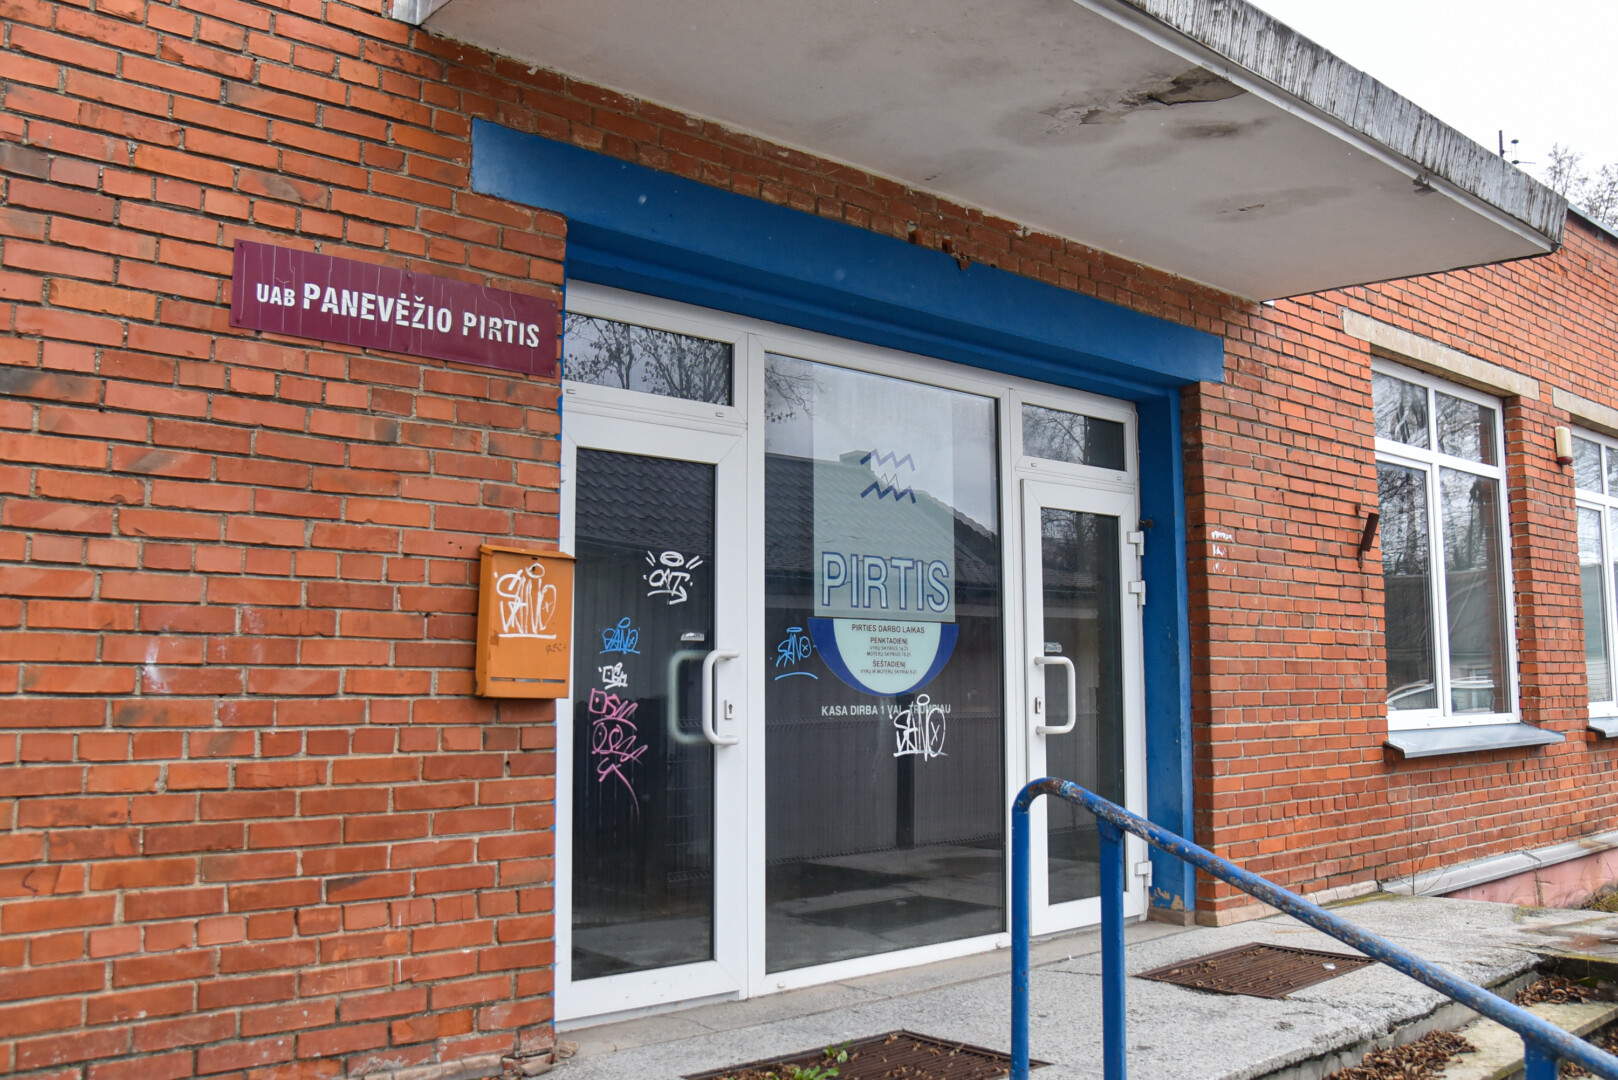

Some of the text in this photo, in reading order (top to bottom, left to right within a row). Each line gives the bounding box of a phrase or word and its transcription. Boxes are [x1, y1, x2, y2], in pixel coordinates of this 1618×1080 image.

[256, 283, 541, 349] UAB PANEVĖŽIO PIRTIS
[821, 551, 951, 614] PIRTIS
[851, 623, 925, 634] PIRTIES DARBO LAIKAS
[870, 636, 908, 645] PENKTADIENĮ
[872, 660, 906, 668] ŠEŠTADIENĮ
[821, 705, 848, 717] KASA
[850, 704, 879, 716] DIRBA
[880, 705, 886, 716] 1
